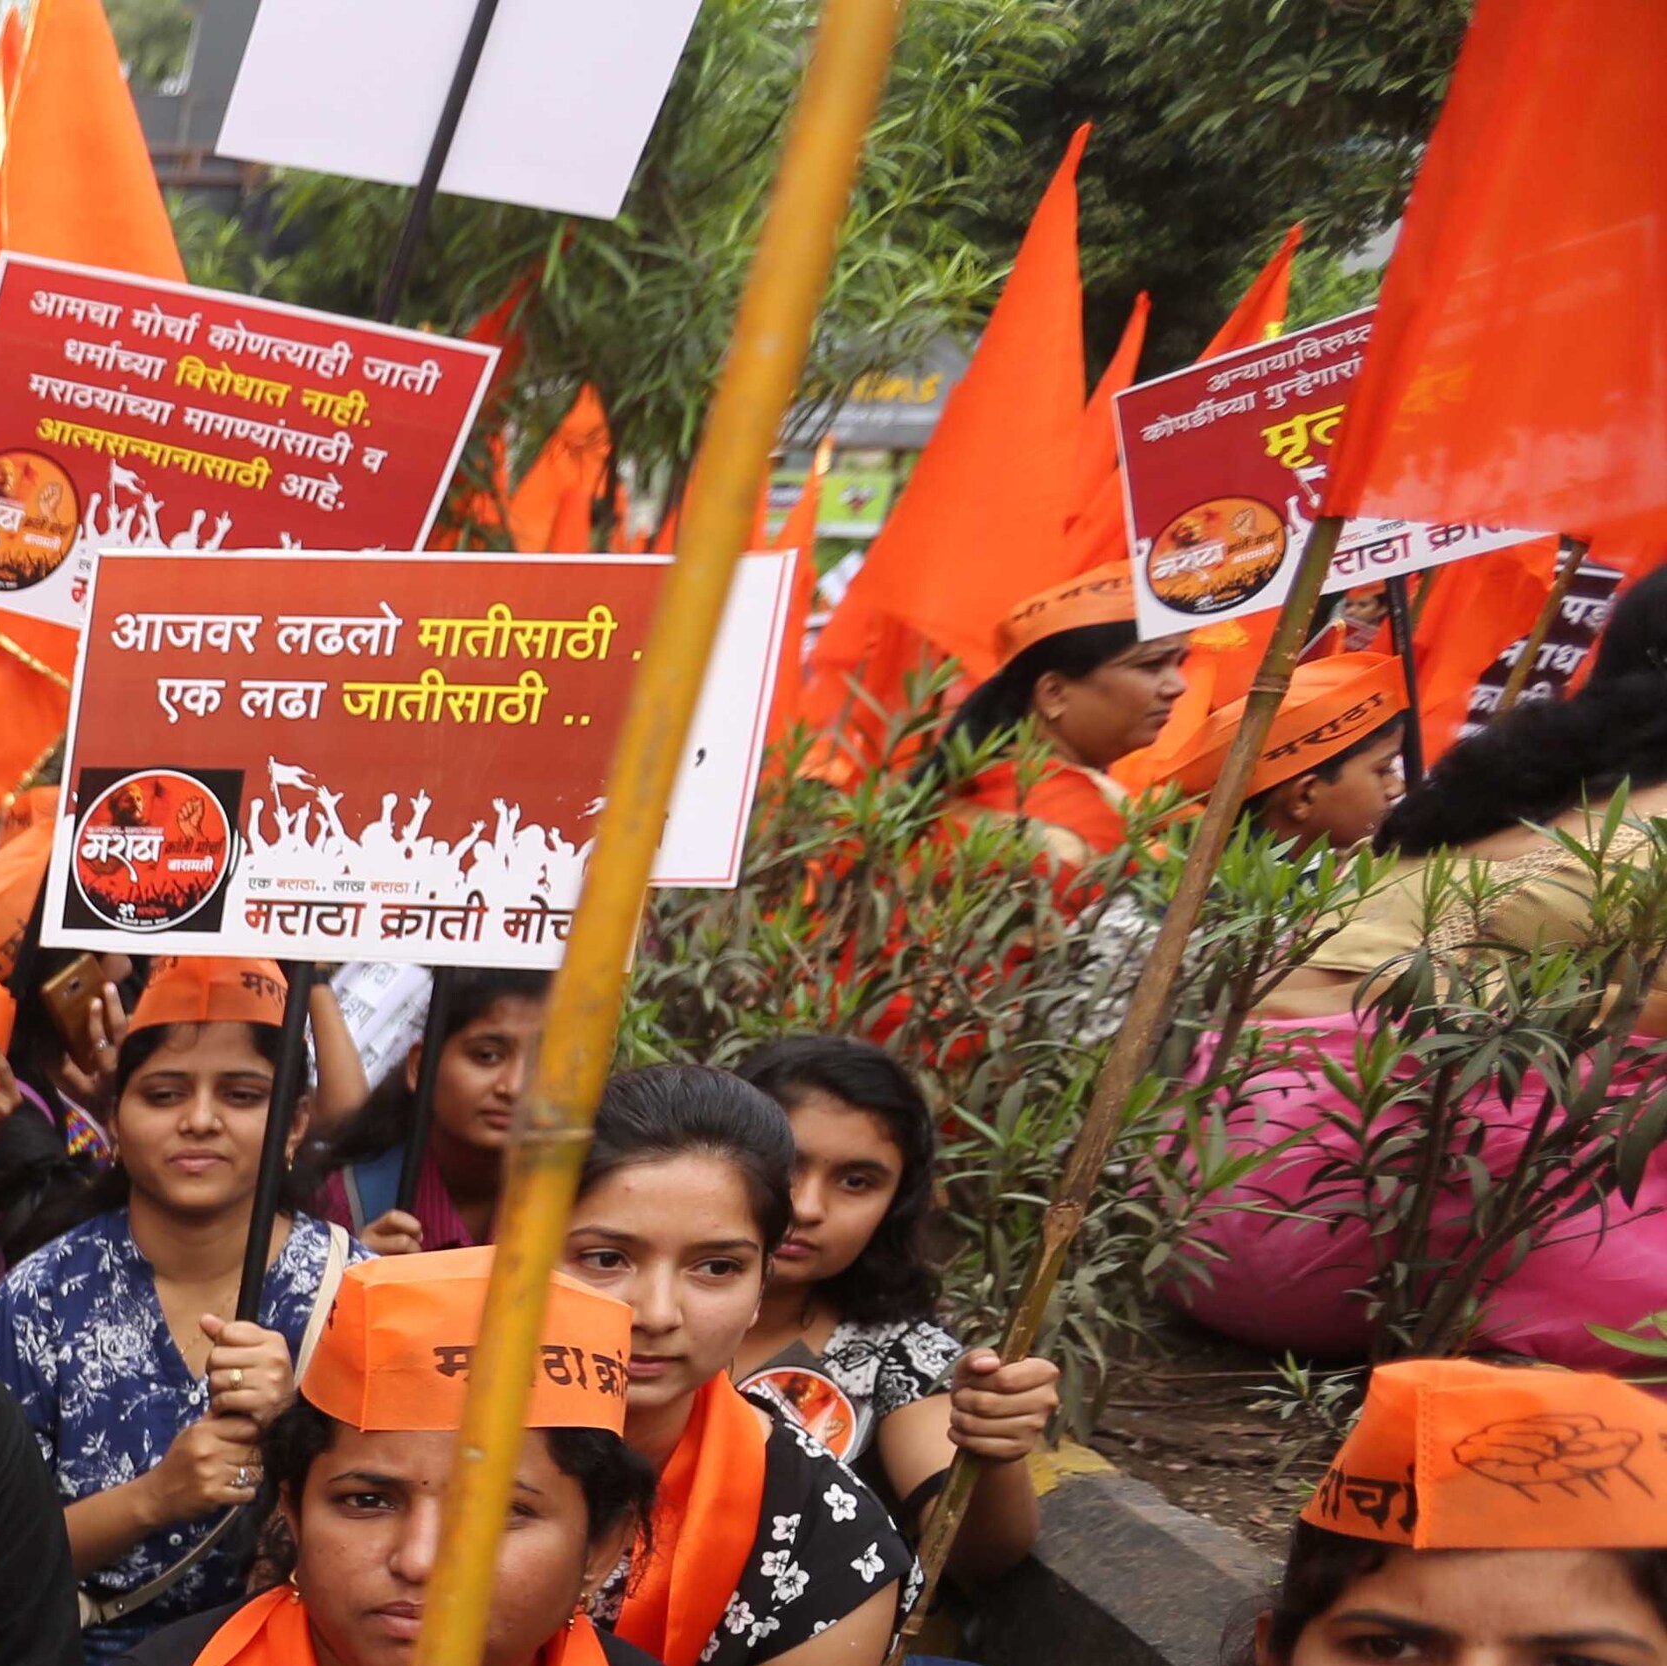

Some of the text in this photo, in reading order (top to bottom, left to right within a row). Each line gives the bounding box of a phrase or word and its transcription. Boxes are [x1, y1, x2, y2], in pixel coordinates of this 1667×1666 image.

[29, 289, 443, 397] आमचा मोर्चा कोणत्याही जाती
[63, 336, 374, 428] धर्माच्या विरोधात नाही.
[1140, 350, 1365, 442] कोपर्डीच्या गुन्हेगारां
[36, 417, 347, 512] आत्मसन्मानासाठी आहे.
[183, 409, 354, 466] मागण्यांसाठी
[361, 445, 389, 474] व
[110, 612, 263, 654] आजवर
[276, 601, 402, 657] लढलो
[418, 602, 618, 660] मातीसाठी
[156, 677, 226, 725] एक
[239, 680, 328, 720] लढा
[342, 668, 549, 725] जातीसाठी
[243, 897, 368, 937] मराठा
[379, 889, 490, 943] क्रांती
